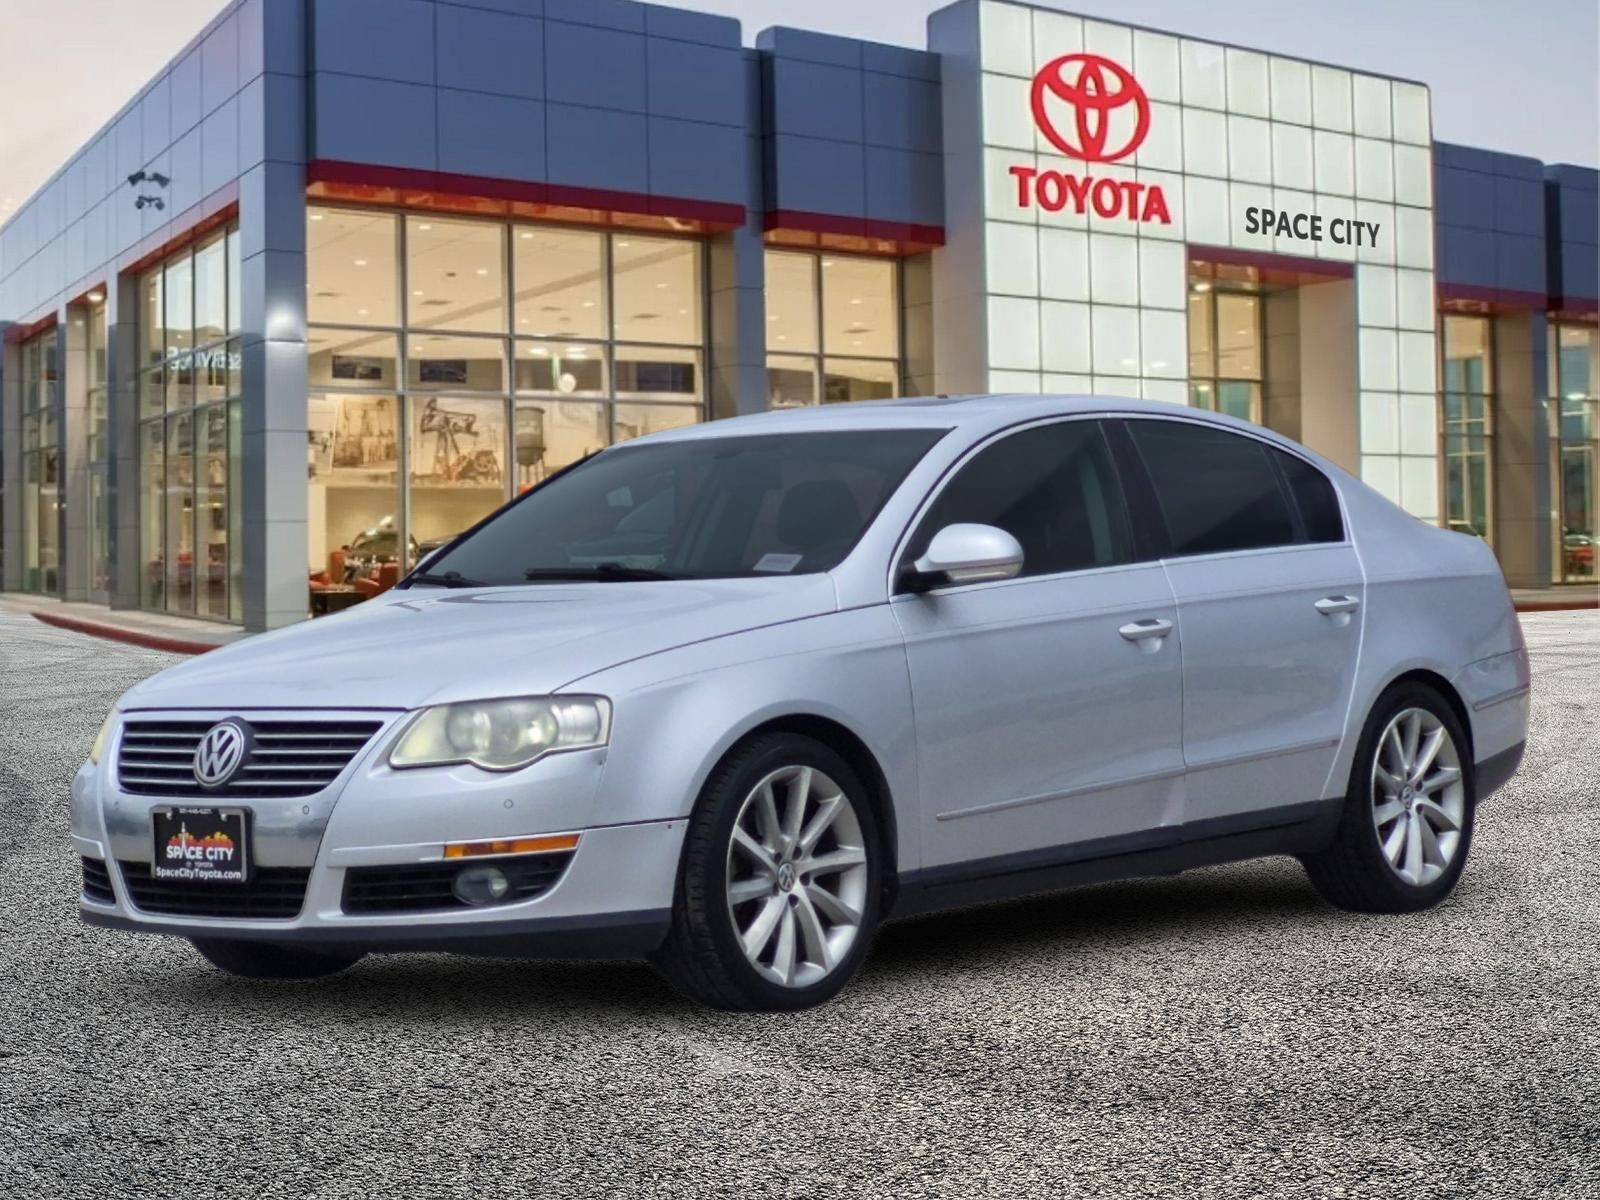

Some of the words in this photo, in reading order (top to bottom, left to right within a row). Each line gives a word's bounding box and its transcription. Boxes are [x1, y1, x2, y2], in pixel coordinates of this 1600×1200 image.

[1009, 166, 1171, 225] TOYOTA
[1245, 206, 1322, 242] SPACE
[1329, 218, 1381, 248] CITY
[166, 844, 203, 860] SPACE
[205, 847, 234, 861] CITY
[156, 866, 242, 880] SpaceCityToyota.com
